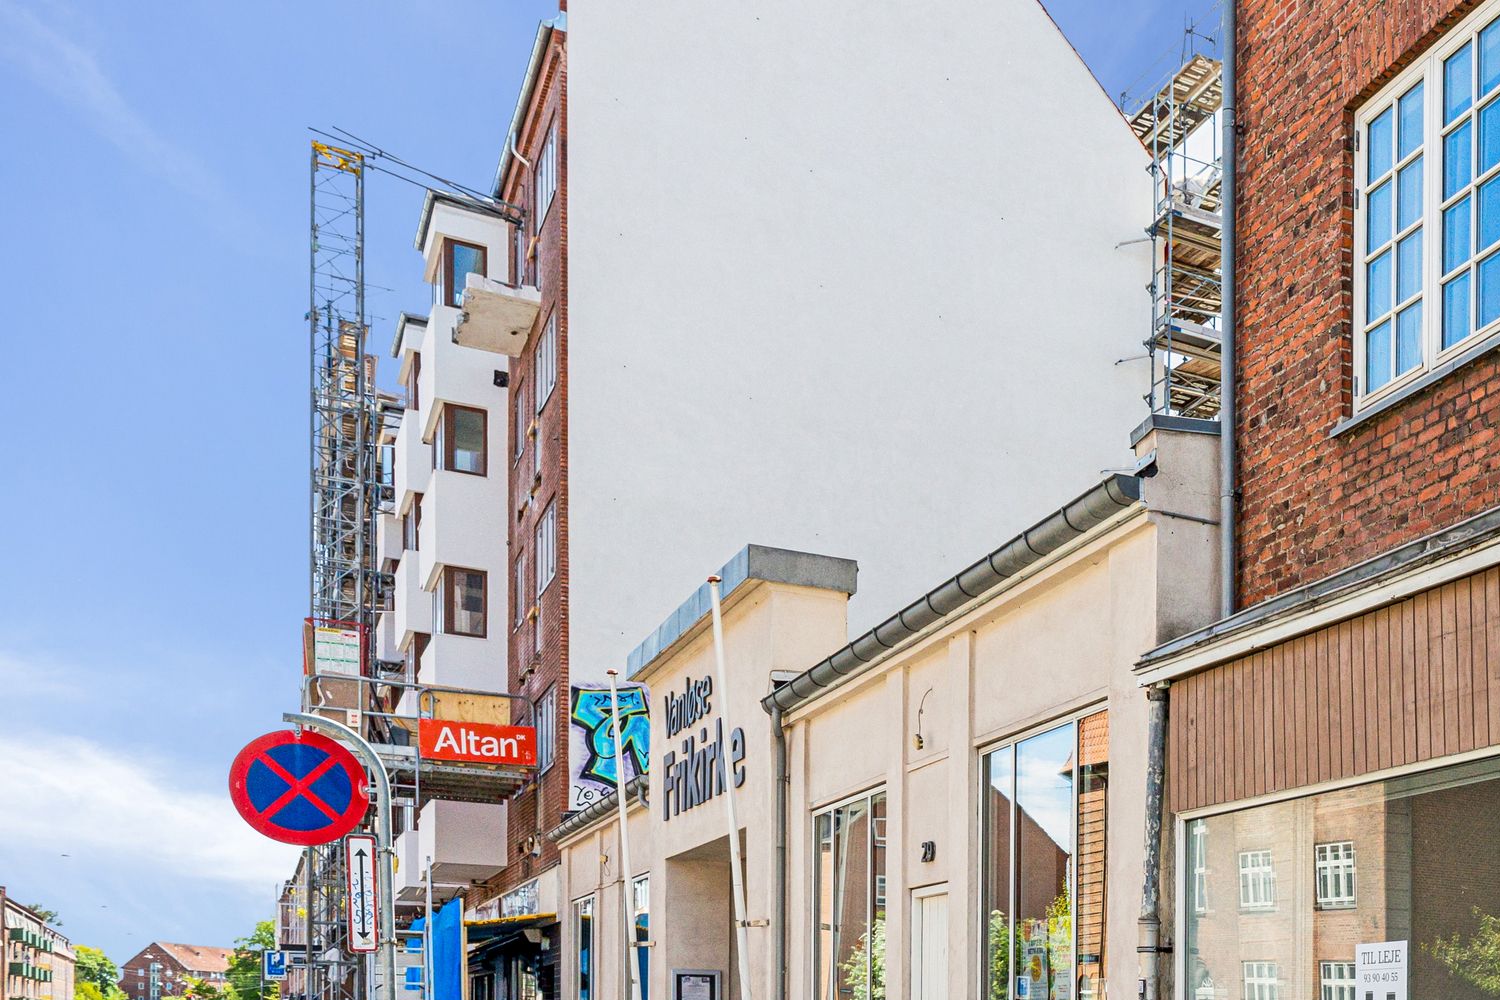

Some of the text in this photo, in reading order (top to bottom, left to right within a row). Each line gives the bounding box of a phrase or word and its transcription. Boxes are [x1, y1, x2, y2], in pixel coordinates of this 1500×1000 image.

[665, 675, 713, 739] Vanløse
[433, 726, 518, 758] Altan
[663, 717, 746, 821] Frikirke
[1361, 949, 1401, 965] TIL LEJE
[1363, 971, 1399, 983] 93 90 40 55
